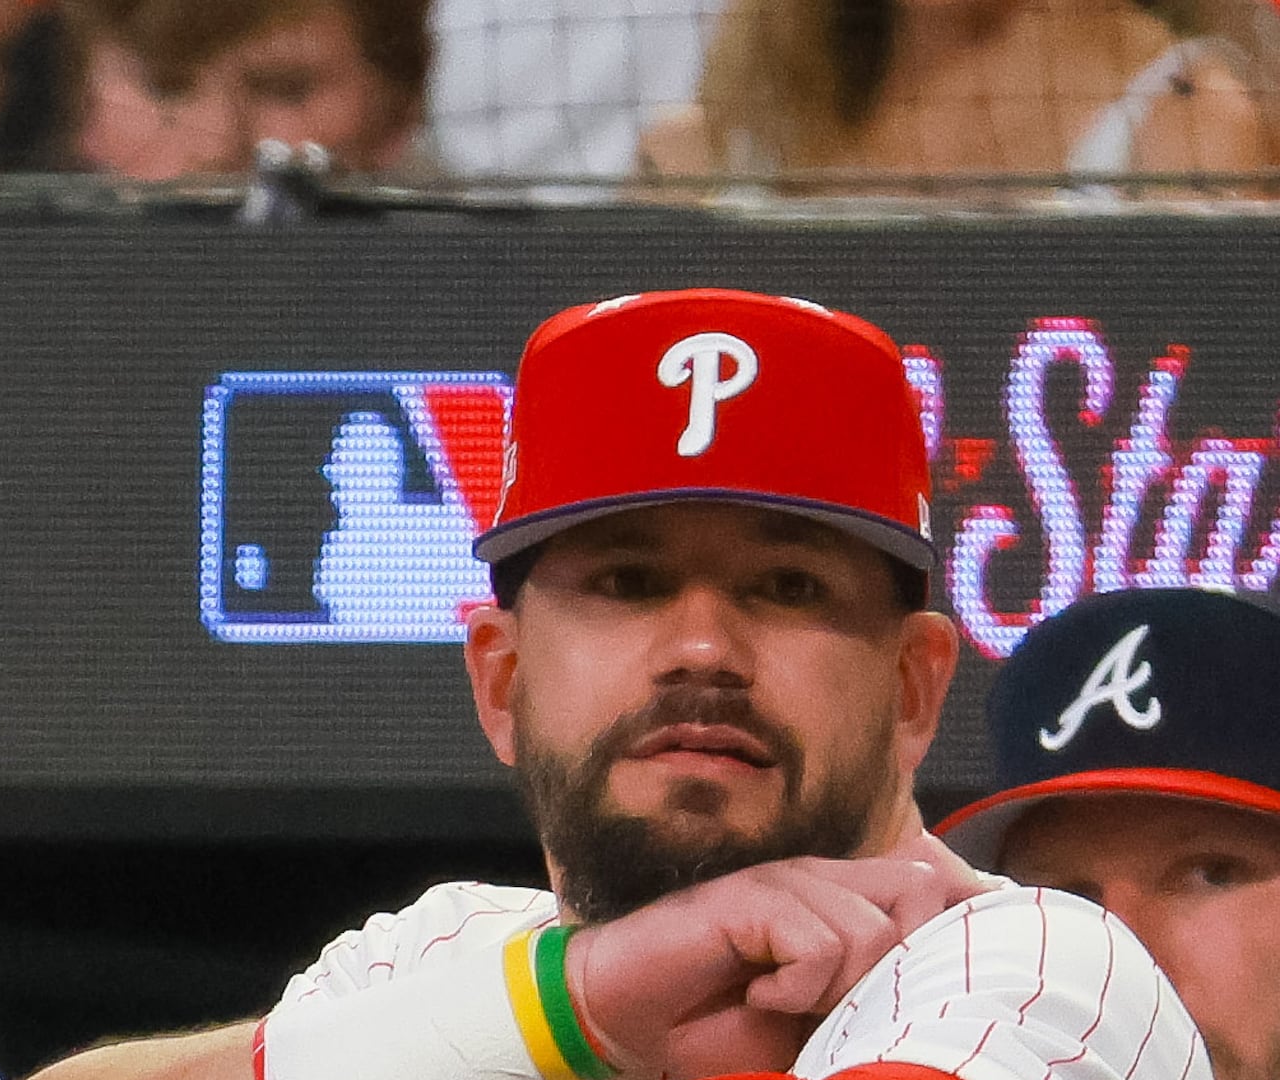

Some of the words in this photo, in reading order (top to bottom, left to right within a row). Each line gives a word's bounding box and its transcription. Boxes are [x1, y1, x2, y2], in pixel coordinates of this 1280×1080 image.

[657, 331, 760, 458] P
[946, 314, 1280, 662] Sta
[1039, 623, 1163, 752] A
